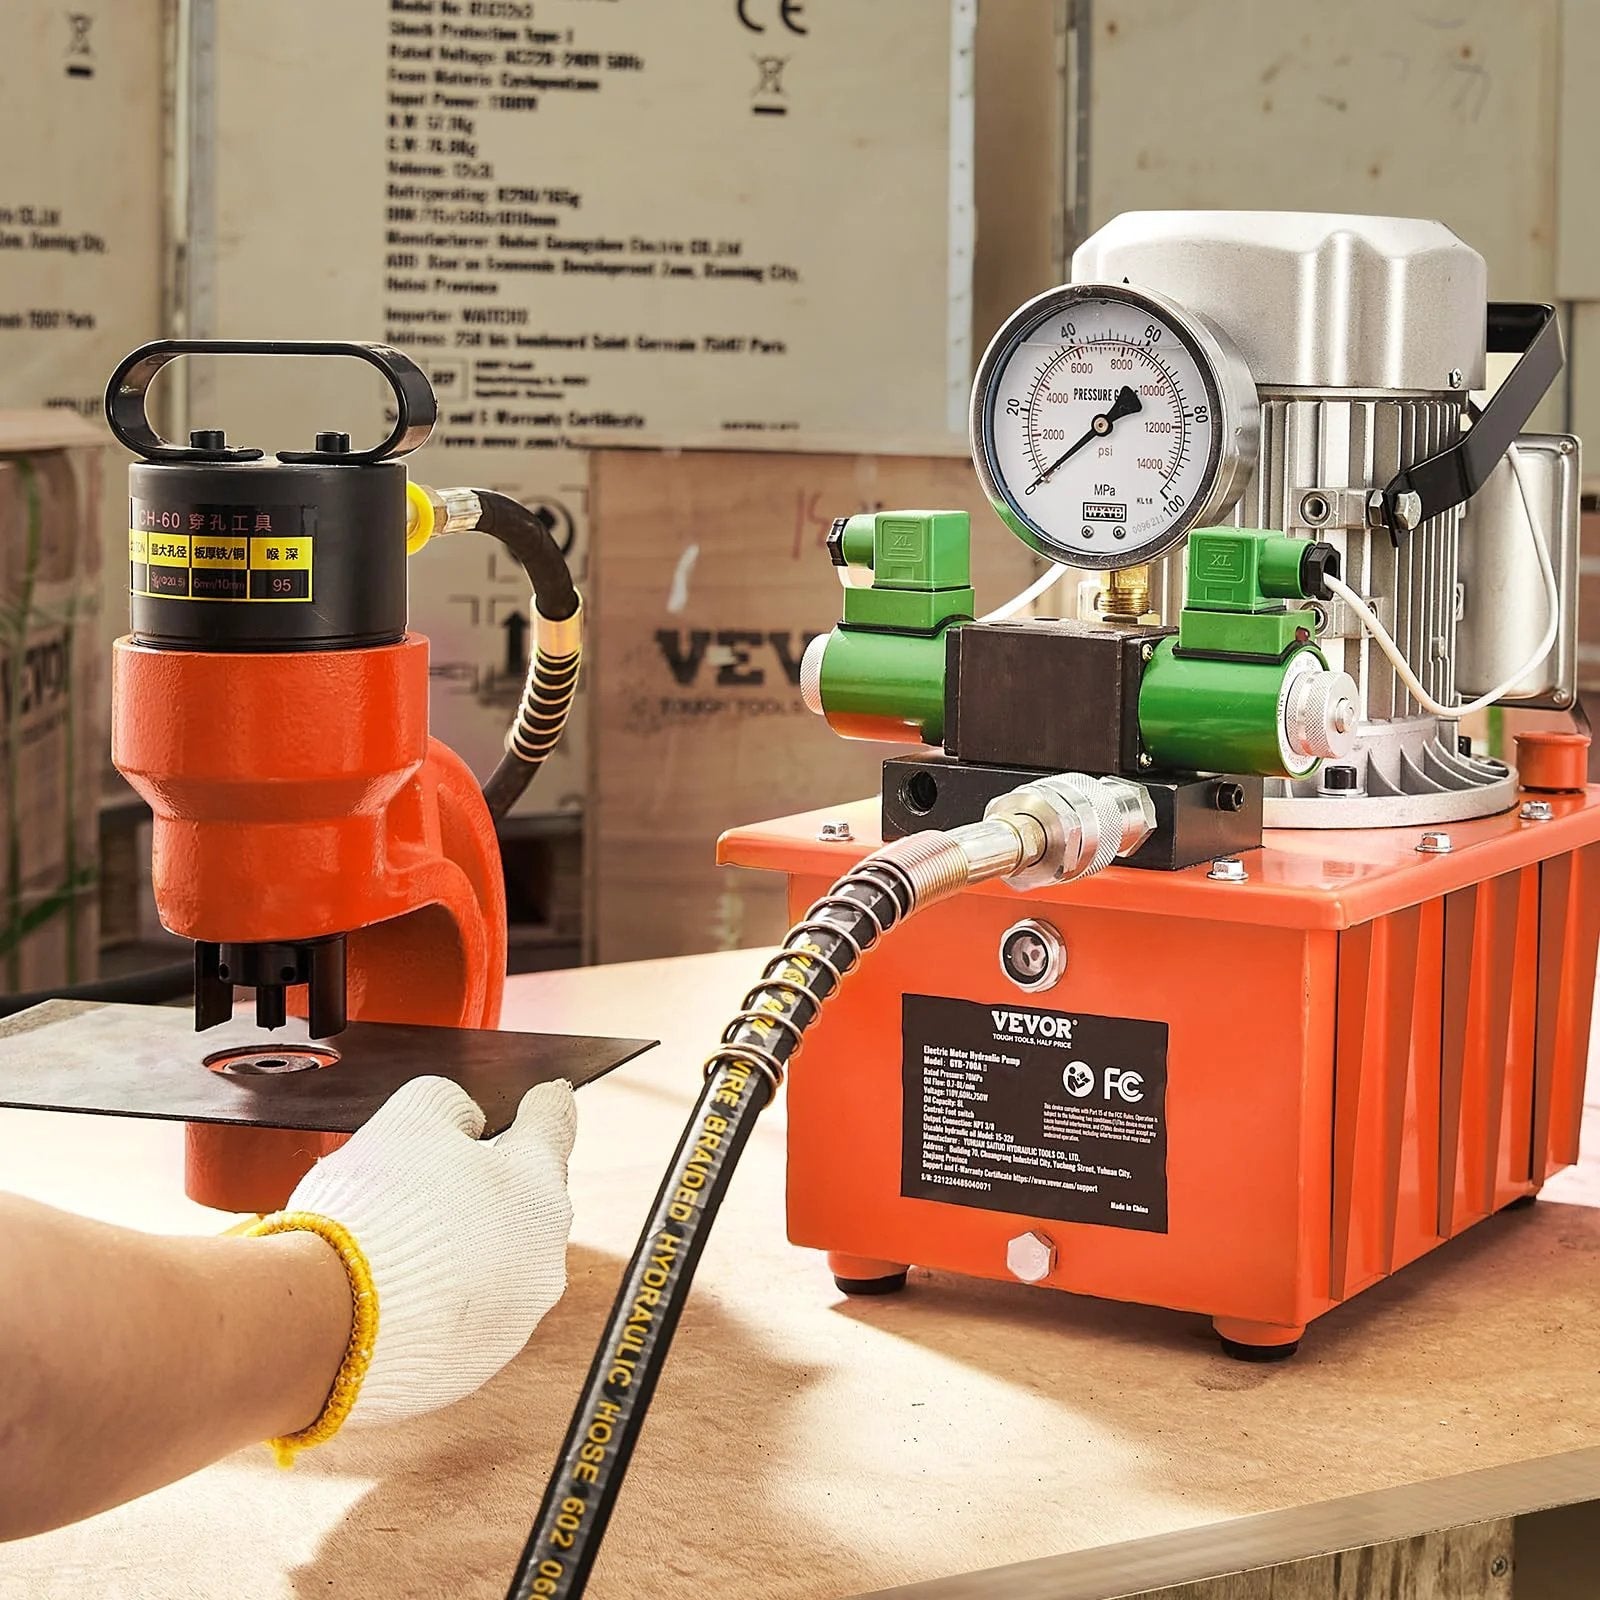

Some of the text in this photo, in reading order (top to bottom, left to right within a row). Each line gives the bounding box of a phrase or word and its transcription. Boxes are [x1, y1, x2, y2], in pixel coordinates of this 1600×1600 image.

[1060, 322, 1076, 339] 40
[1144, 324, 1162, 343] 60
[1071, 362, 1093, 374] 6000
[1110, 359, 1132, 371] 8000
[1046, 392, 1068, 404] 4000
[1073, 388, 1112, 402] PRESSURE
[1139, 385, 1166, 397] 10000
[1006, 398, 1020, 417] 20
[1194, 405, 1208, 424] 80
[1043, 429, 1064, 441] 2000
[1145, 422, 1171, 434] 12000
[1098, 446, 1113, 457] psi
[1137, 458, 1163, 470] 14000
[1094, 484, 1116, 496] MPa
[1162, 495, 1185, 518] 100
[139, 511, 272, 532] CH-60 穿孔工具
[1210, 554, 1232, 567] XL
[272, 579, 292, 591] 95
[991, 1010, 1072, 1040] VEVOR
[992, 1032, 1072, 1049] TOUGH TOOLS, HALF PRICE
[923, 1045, 1021, 1067] Electric Motor Hydraulic Pump
[923, 1067, 940, 1077] Rated
[716, 1059, 754, 1108] WIRE
[1006, 1143, 1038, 1156] HYDRAULIC
[1038, 1148, 1056, 1159] TOOLS
[1012, 1154, 1039, 1167] Industrial
[668, 1114, 728, 1223] BRAIDED
[1110, 1201, 1149, 1214] Made in China
[608, 1232, 681, 1388] HYDRAULIC
[572, 1400, 622, 1485] HOSE
[550, 1496, 586, 1549] 602
